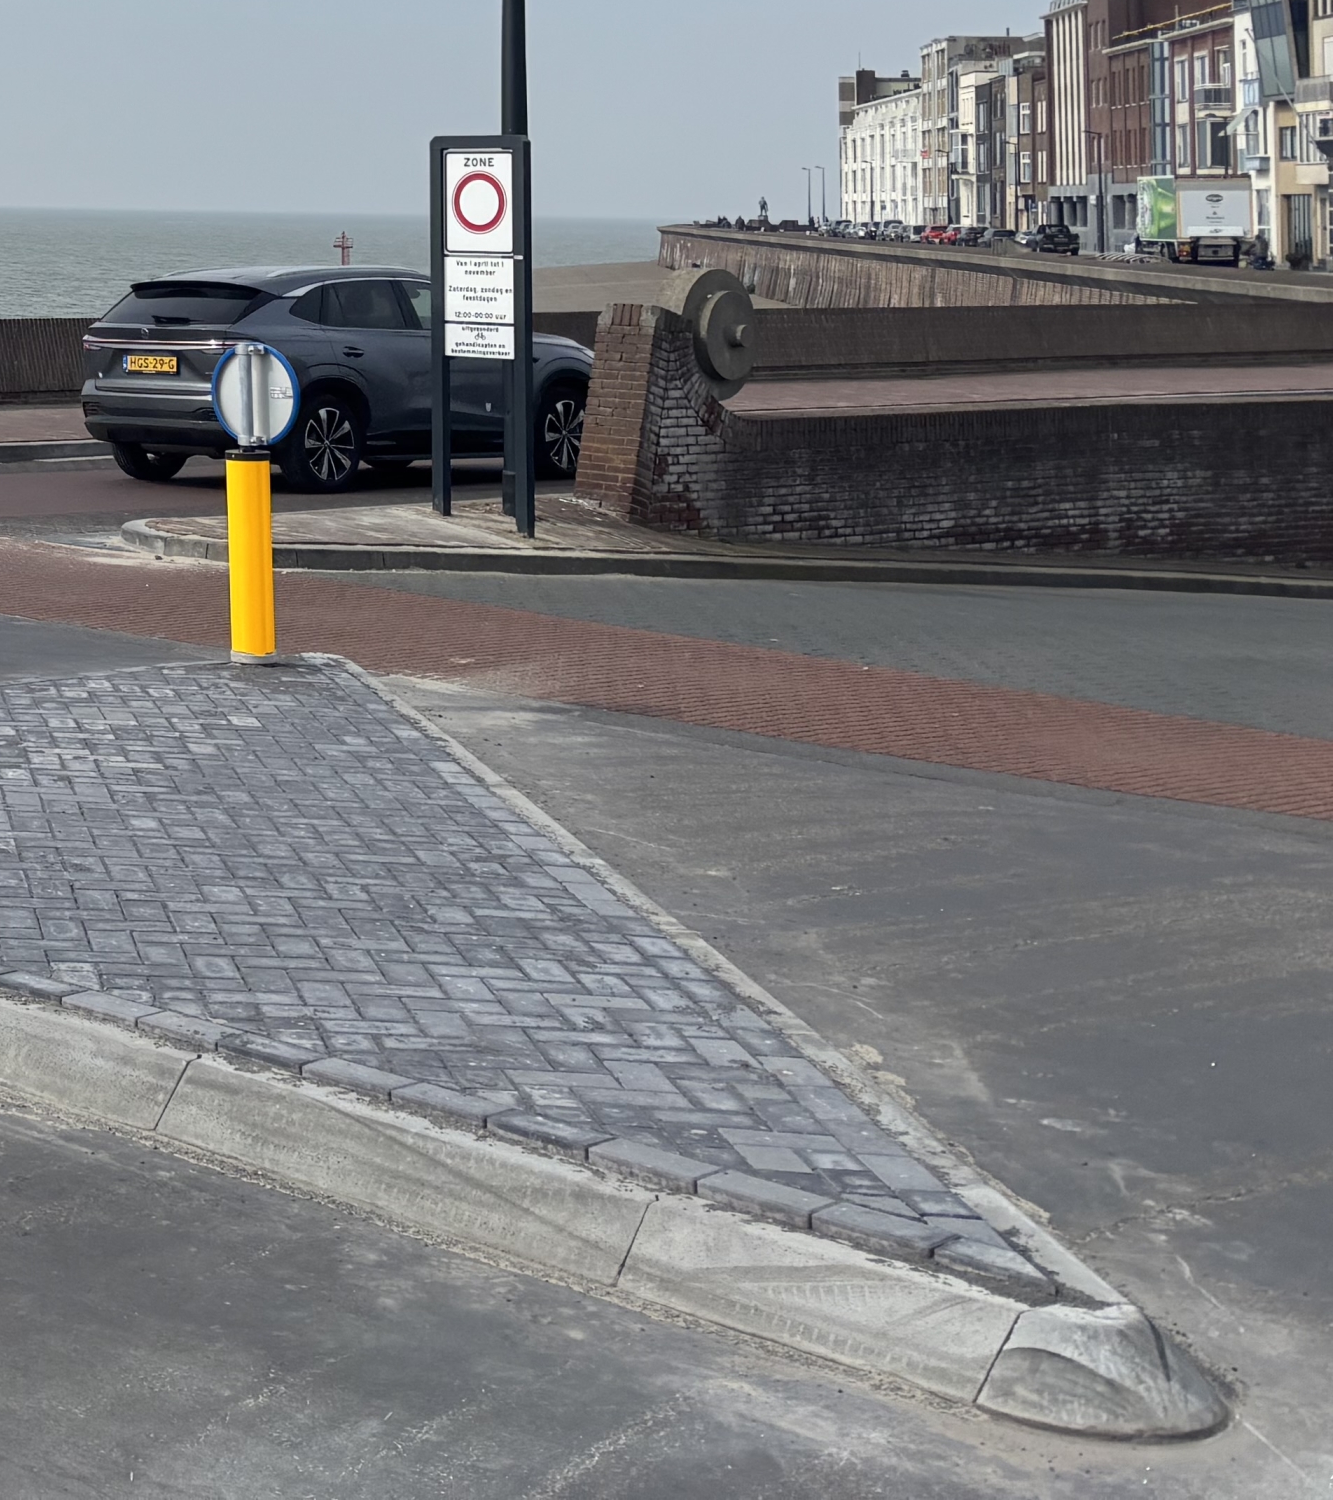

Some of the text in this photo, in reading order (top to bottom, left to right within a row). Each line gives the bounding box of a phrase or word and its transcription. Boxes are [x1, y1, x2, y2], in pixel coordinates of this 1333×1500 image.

[463, 157, 495, 167] ZONE
[473, 260, 489, 268] april
[480, 287, 503, 295] zondag
[462, 294, 498, 303] feestdagen
[130, 357, 175, 369] HGS-29-G
